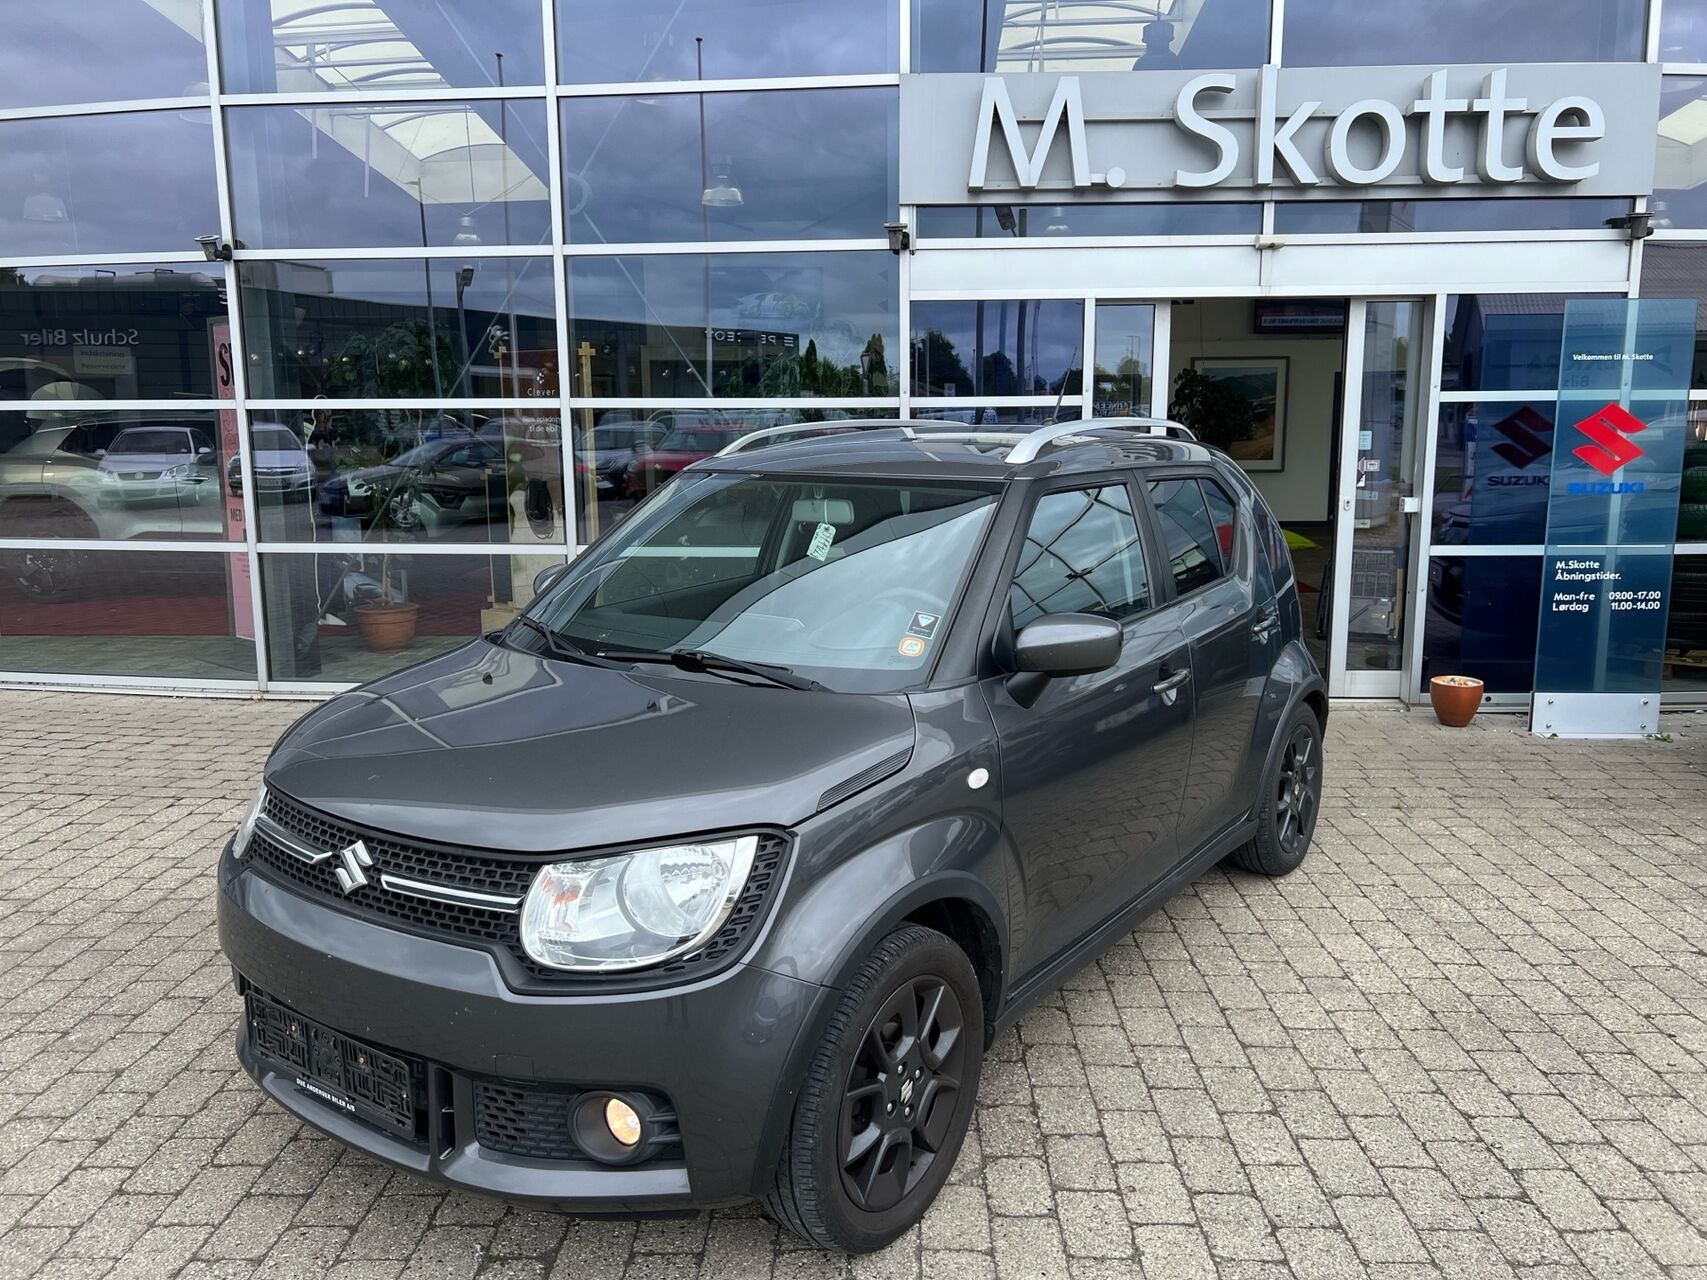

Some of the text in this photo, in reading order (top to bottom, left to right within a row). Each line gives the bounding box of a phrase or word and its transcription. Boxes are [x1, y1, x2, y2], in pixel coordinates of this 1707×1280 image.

[968, 64, 1606, 192] M. Skotte
[1573, 353, 1613, 361] Velkommen
[1622, 353, 1631, 361] M.
[1631, 353, 1654, 361] Skotte
[527, 387, 556, 396] Clever
[1487, 475, 1549, 487] SUZUK
[1568, 482, 1645, 495] SUZUKI
[1555, 560, 1600, 570] M.Skotte
[1555, 569, 1622, 582] Åbningstider.
[1553, 592, 1596, 601] Man-fre
[1552, 601, 1661, 612] Lørdag 11.00-14.00
